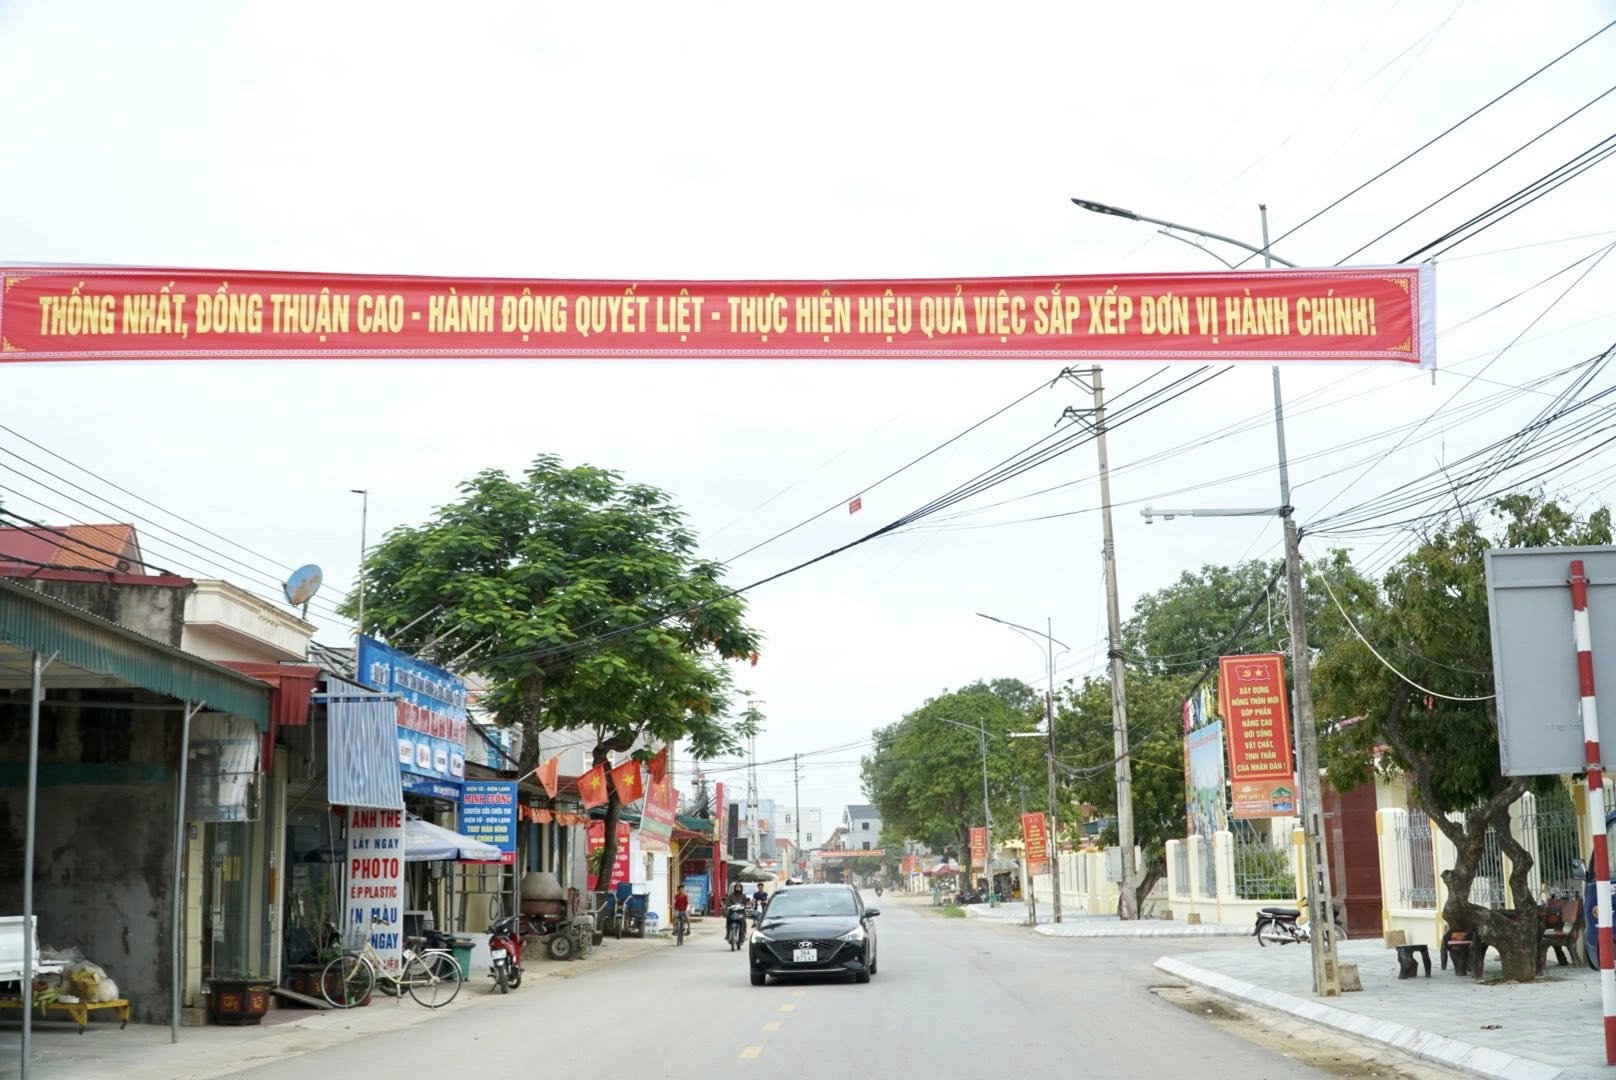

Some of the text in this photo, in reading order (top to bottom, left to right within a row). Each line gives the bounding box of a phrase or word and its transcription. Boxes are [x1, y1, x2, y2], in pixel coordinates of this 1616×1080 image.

[39, 281, 115, 335] THỐNG
[122, 281, 188, 339] NHẤT,
[196, 281, 263, 333] ĐỒNG
[271, 287, 349, 342] THUẬN
[357, 295, 404, 333] CAO
[428, 287, 494, 333] HÀNH
[502, 288, 567, 342] ĐỘNG
[575, 283, 649, 337] QUYẾT
[656, 288, 704, 342] LIỆT
[728, 292, 788, 342] THỰC
[799, 289, 851, 342] HIỆN
[859, 289, 911, 342] HIỆU
[919, 284, 968, 338] QUẢ
[973, 289, 1026, 343] VIỆC
[1034, 283, 1080, 335] SẮP
[1088, 284, 1132, 335] XẾP
[1140, 292, 1190, 335] ĐƠN
[1195, 296, 1219, 344] VỊ
[1225, 289, 1290, 336] HÀNH
[1296, 289, 1376, 336] CHÍNH!
[464, 794, 485, 804] MINH
[374, 837, 399, 849] NGAY
[352, 858, 399, 879] PHOTO
[365, 886, 397, 898] PLASTIC
[351, 908, 363, 923] IN
[371, 932, 398, 949] NGAY
